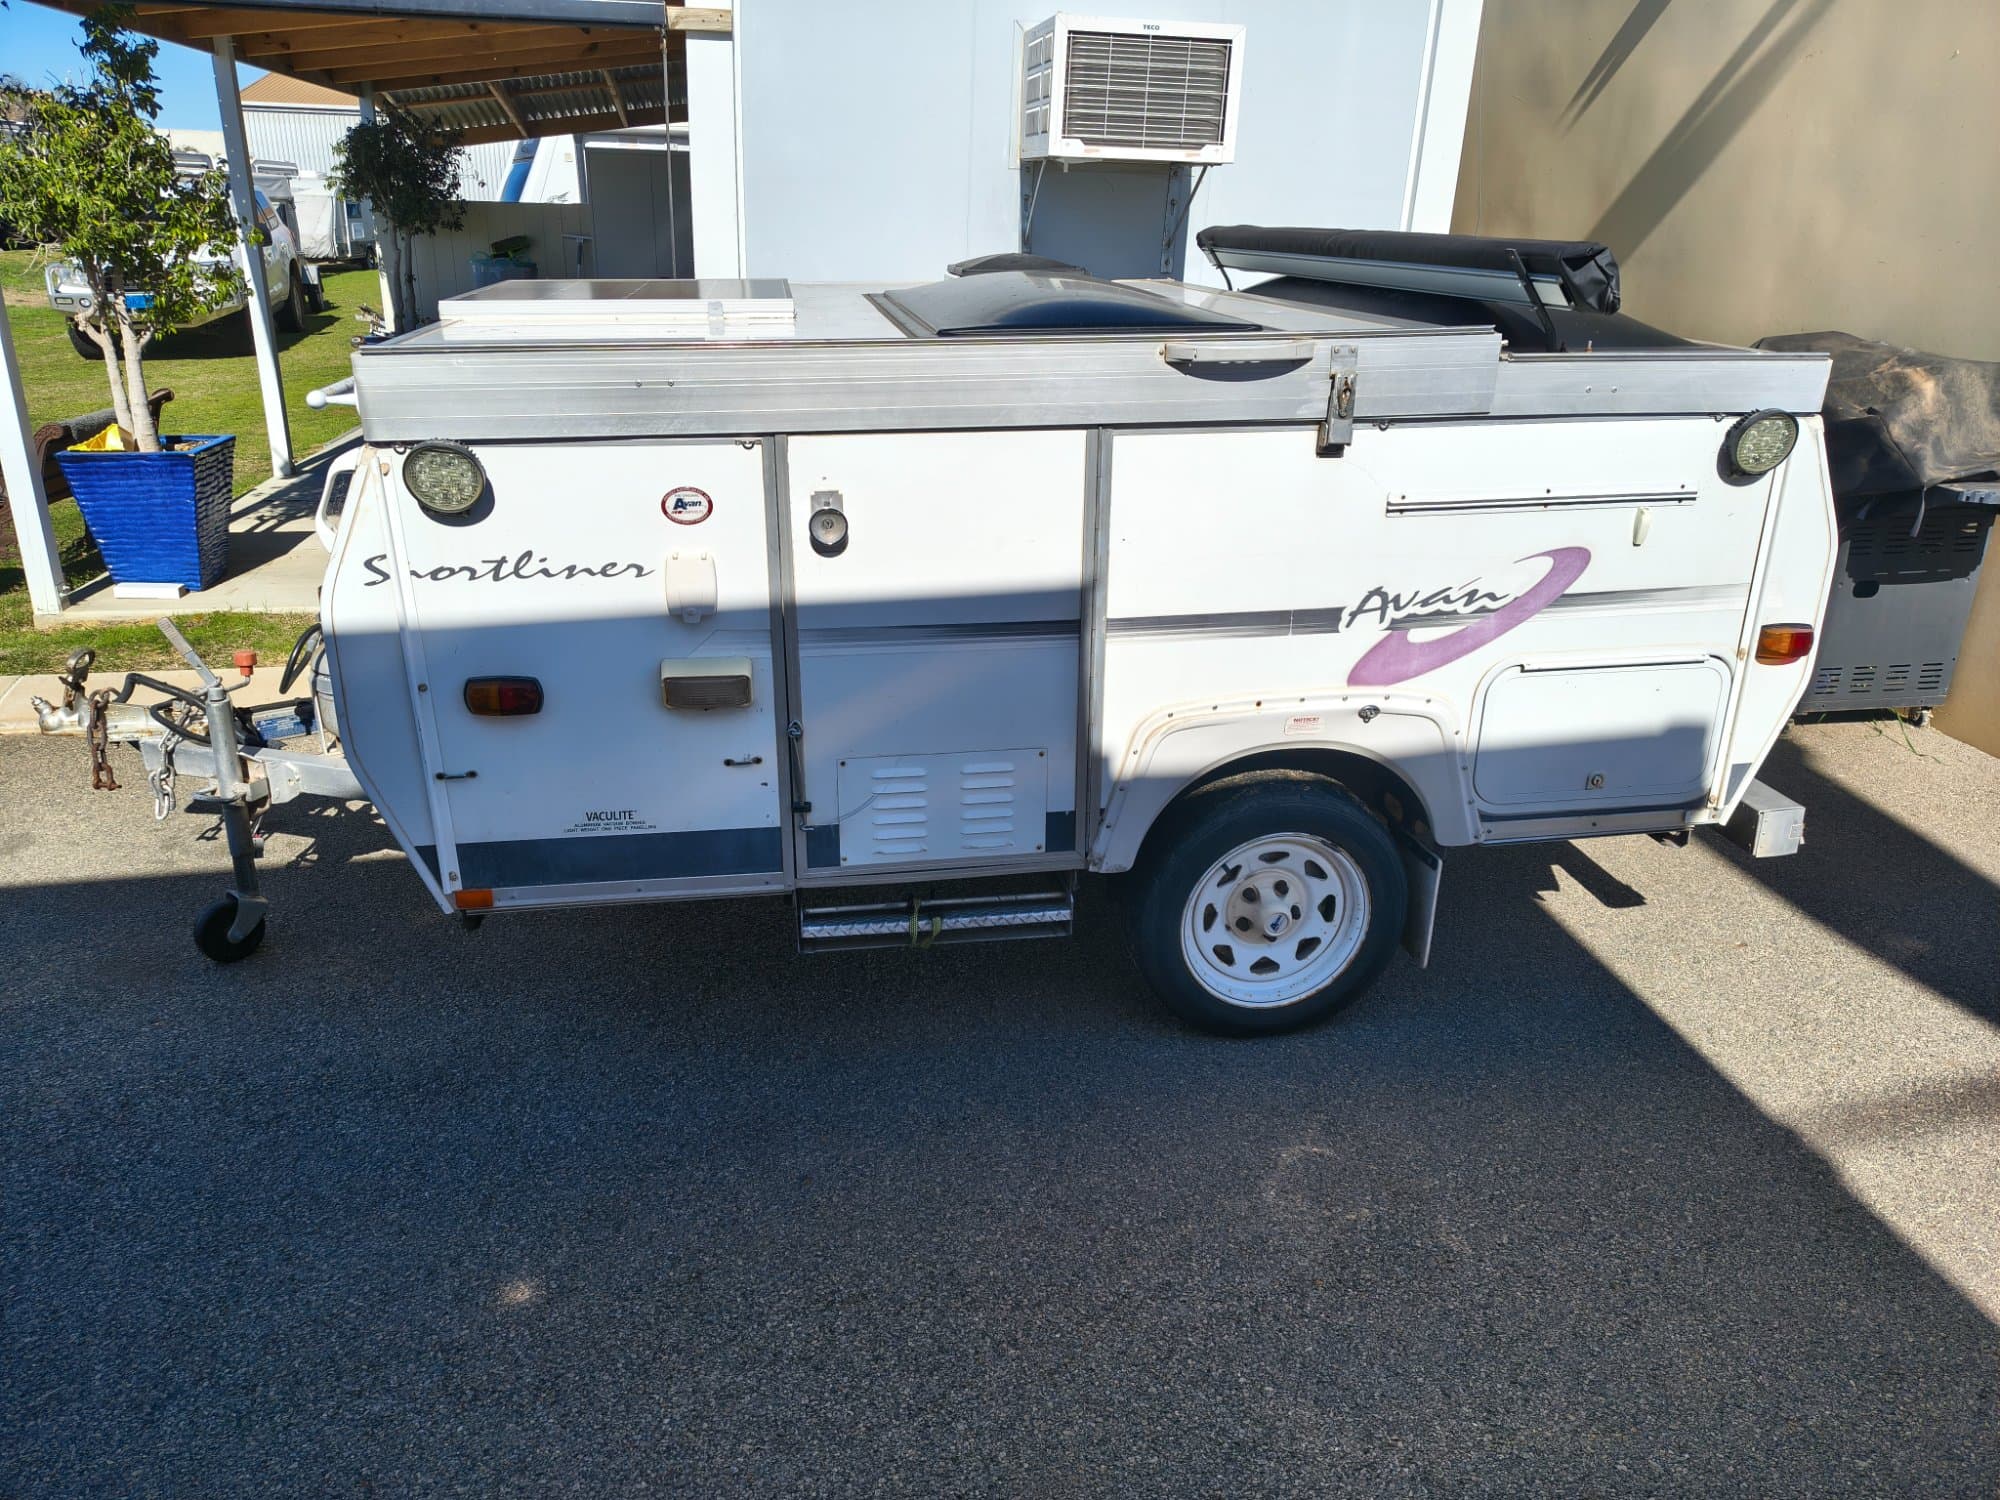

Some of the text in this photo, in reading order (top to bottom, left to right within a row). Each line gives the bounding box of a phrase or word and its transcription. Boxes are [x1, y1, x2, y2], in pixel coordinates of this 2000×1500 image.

[673, 497, 702, 510] Avan
[363, 550, 656, 587] Sortliner
[585, 810, 635, 822] VACULITE
